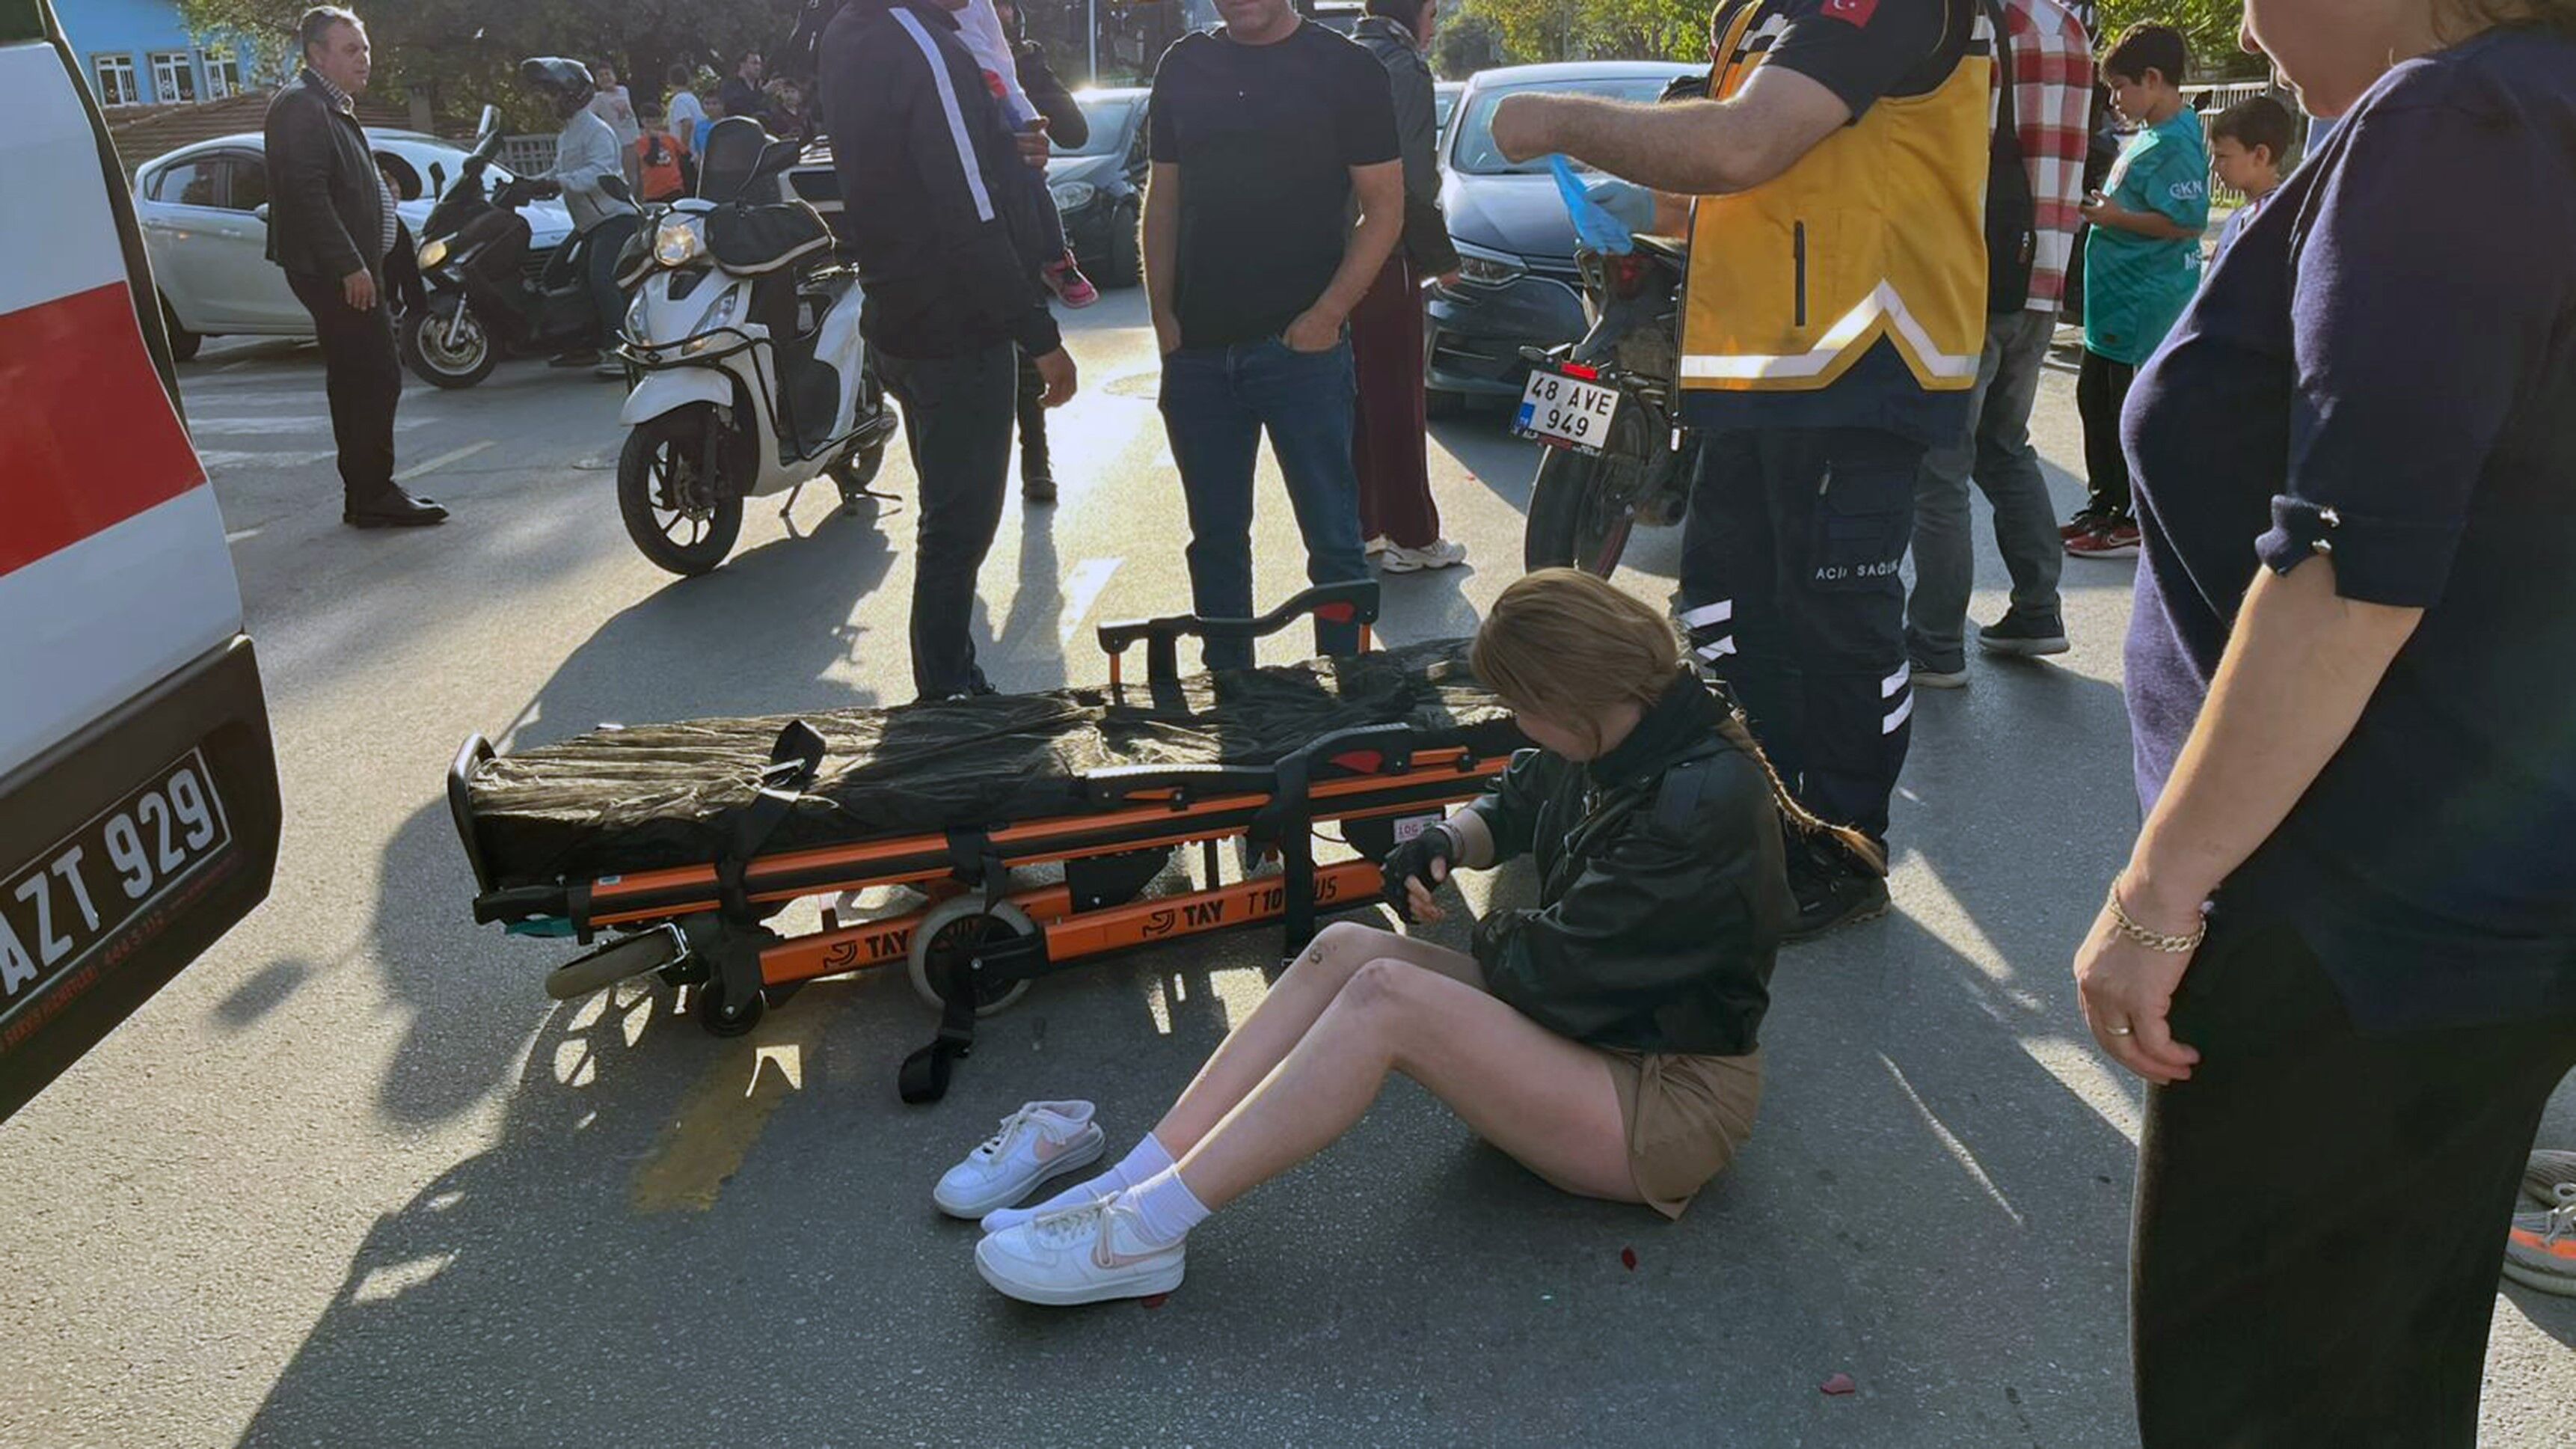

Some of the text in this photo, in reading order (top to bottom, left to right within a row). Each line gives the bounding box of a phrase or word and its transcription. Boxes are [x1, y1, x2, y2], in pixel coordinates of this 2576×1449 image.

[1531, 378, 1611, 415] 48 AVE
[1547, 410, 1589, 437] 949
[0, 845, 100, 995] AZT
[104, 768, 214, 898] 929
[1183, 900, 1224, 927] TAY
[865, 930, 910, 958] TAY
